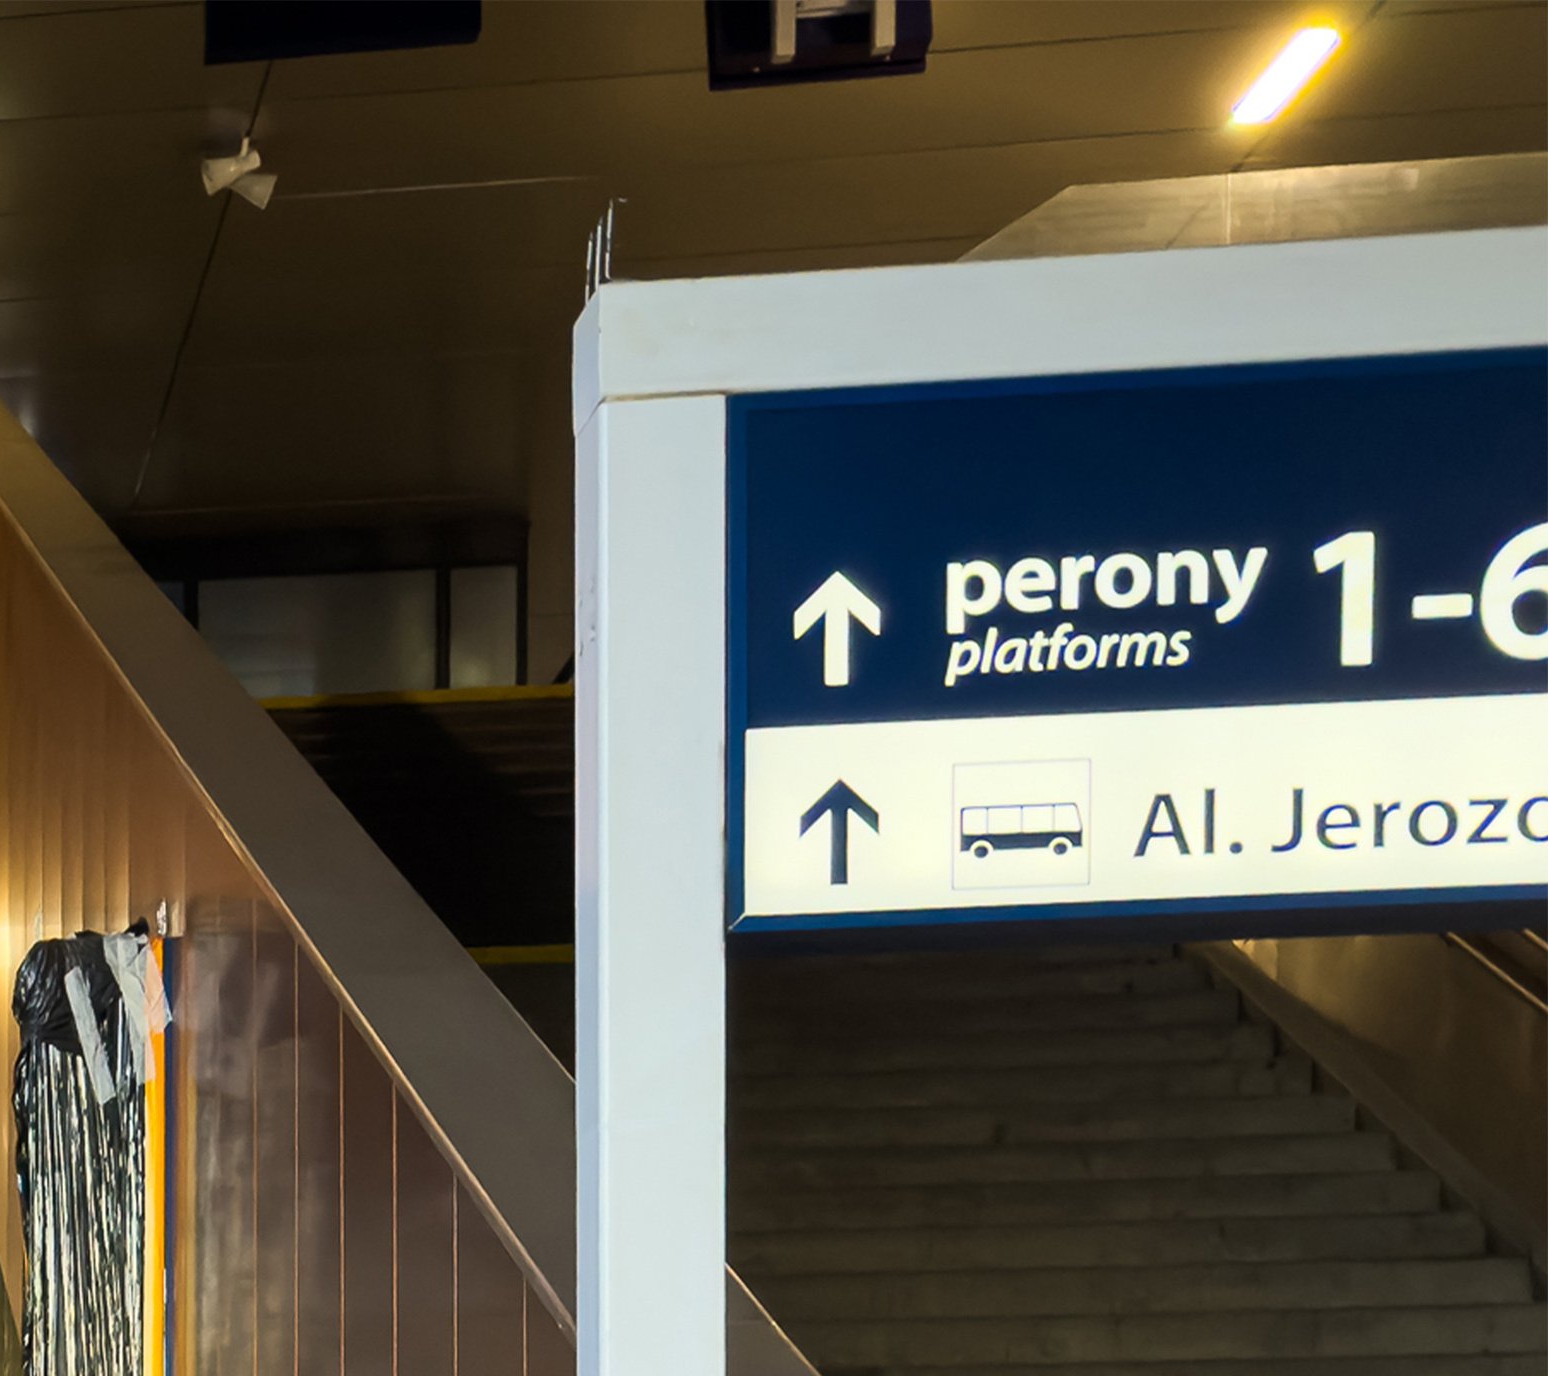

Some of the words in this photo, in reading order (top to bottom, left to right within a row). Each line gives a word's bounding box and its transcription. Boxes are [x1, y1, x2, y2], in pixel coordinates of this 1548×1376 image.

[945, 546, 1269, 635] perony
[943, 621, 1193, 688] platforms
[1132, 786, 1245, 858] Al.
